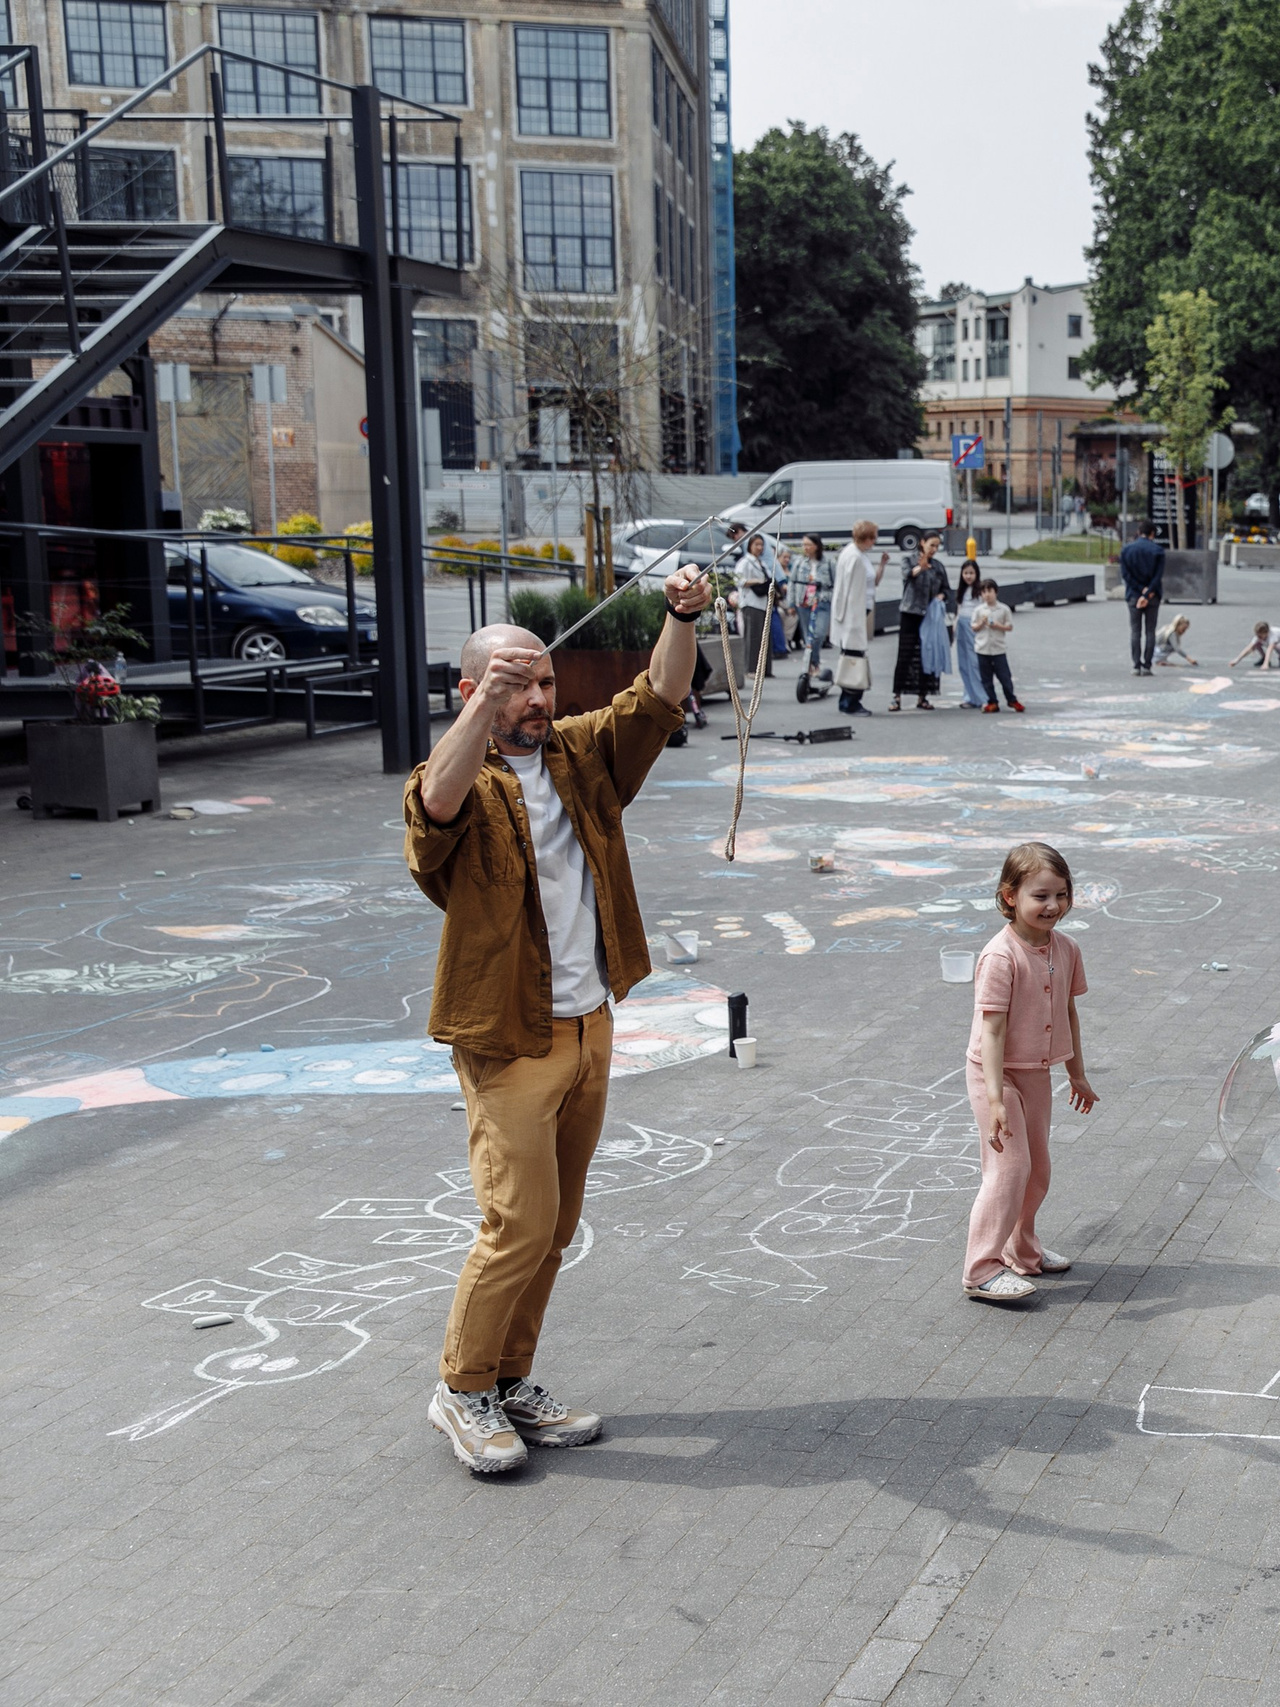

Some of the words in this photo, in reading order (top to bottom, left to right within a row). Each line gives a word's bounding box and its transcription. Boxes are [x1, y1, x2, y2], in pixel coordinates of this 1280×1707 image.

[891, 1093, 936, 1109] 3
[657, 1152, 690, 1168] 2
[916, 1163, 981, 1189] 8
[821, 1189, 901, 1213] 10
[353, 1275, 416, 1292] 8
[285, 1302, 361, 1321] 10
